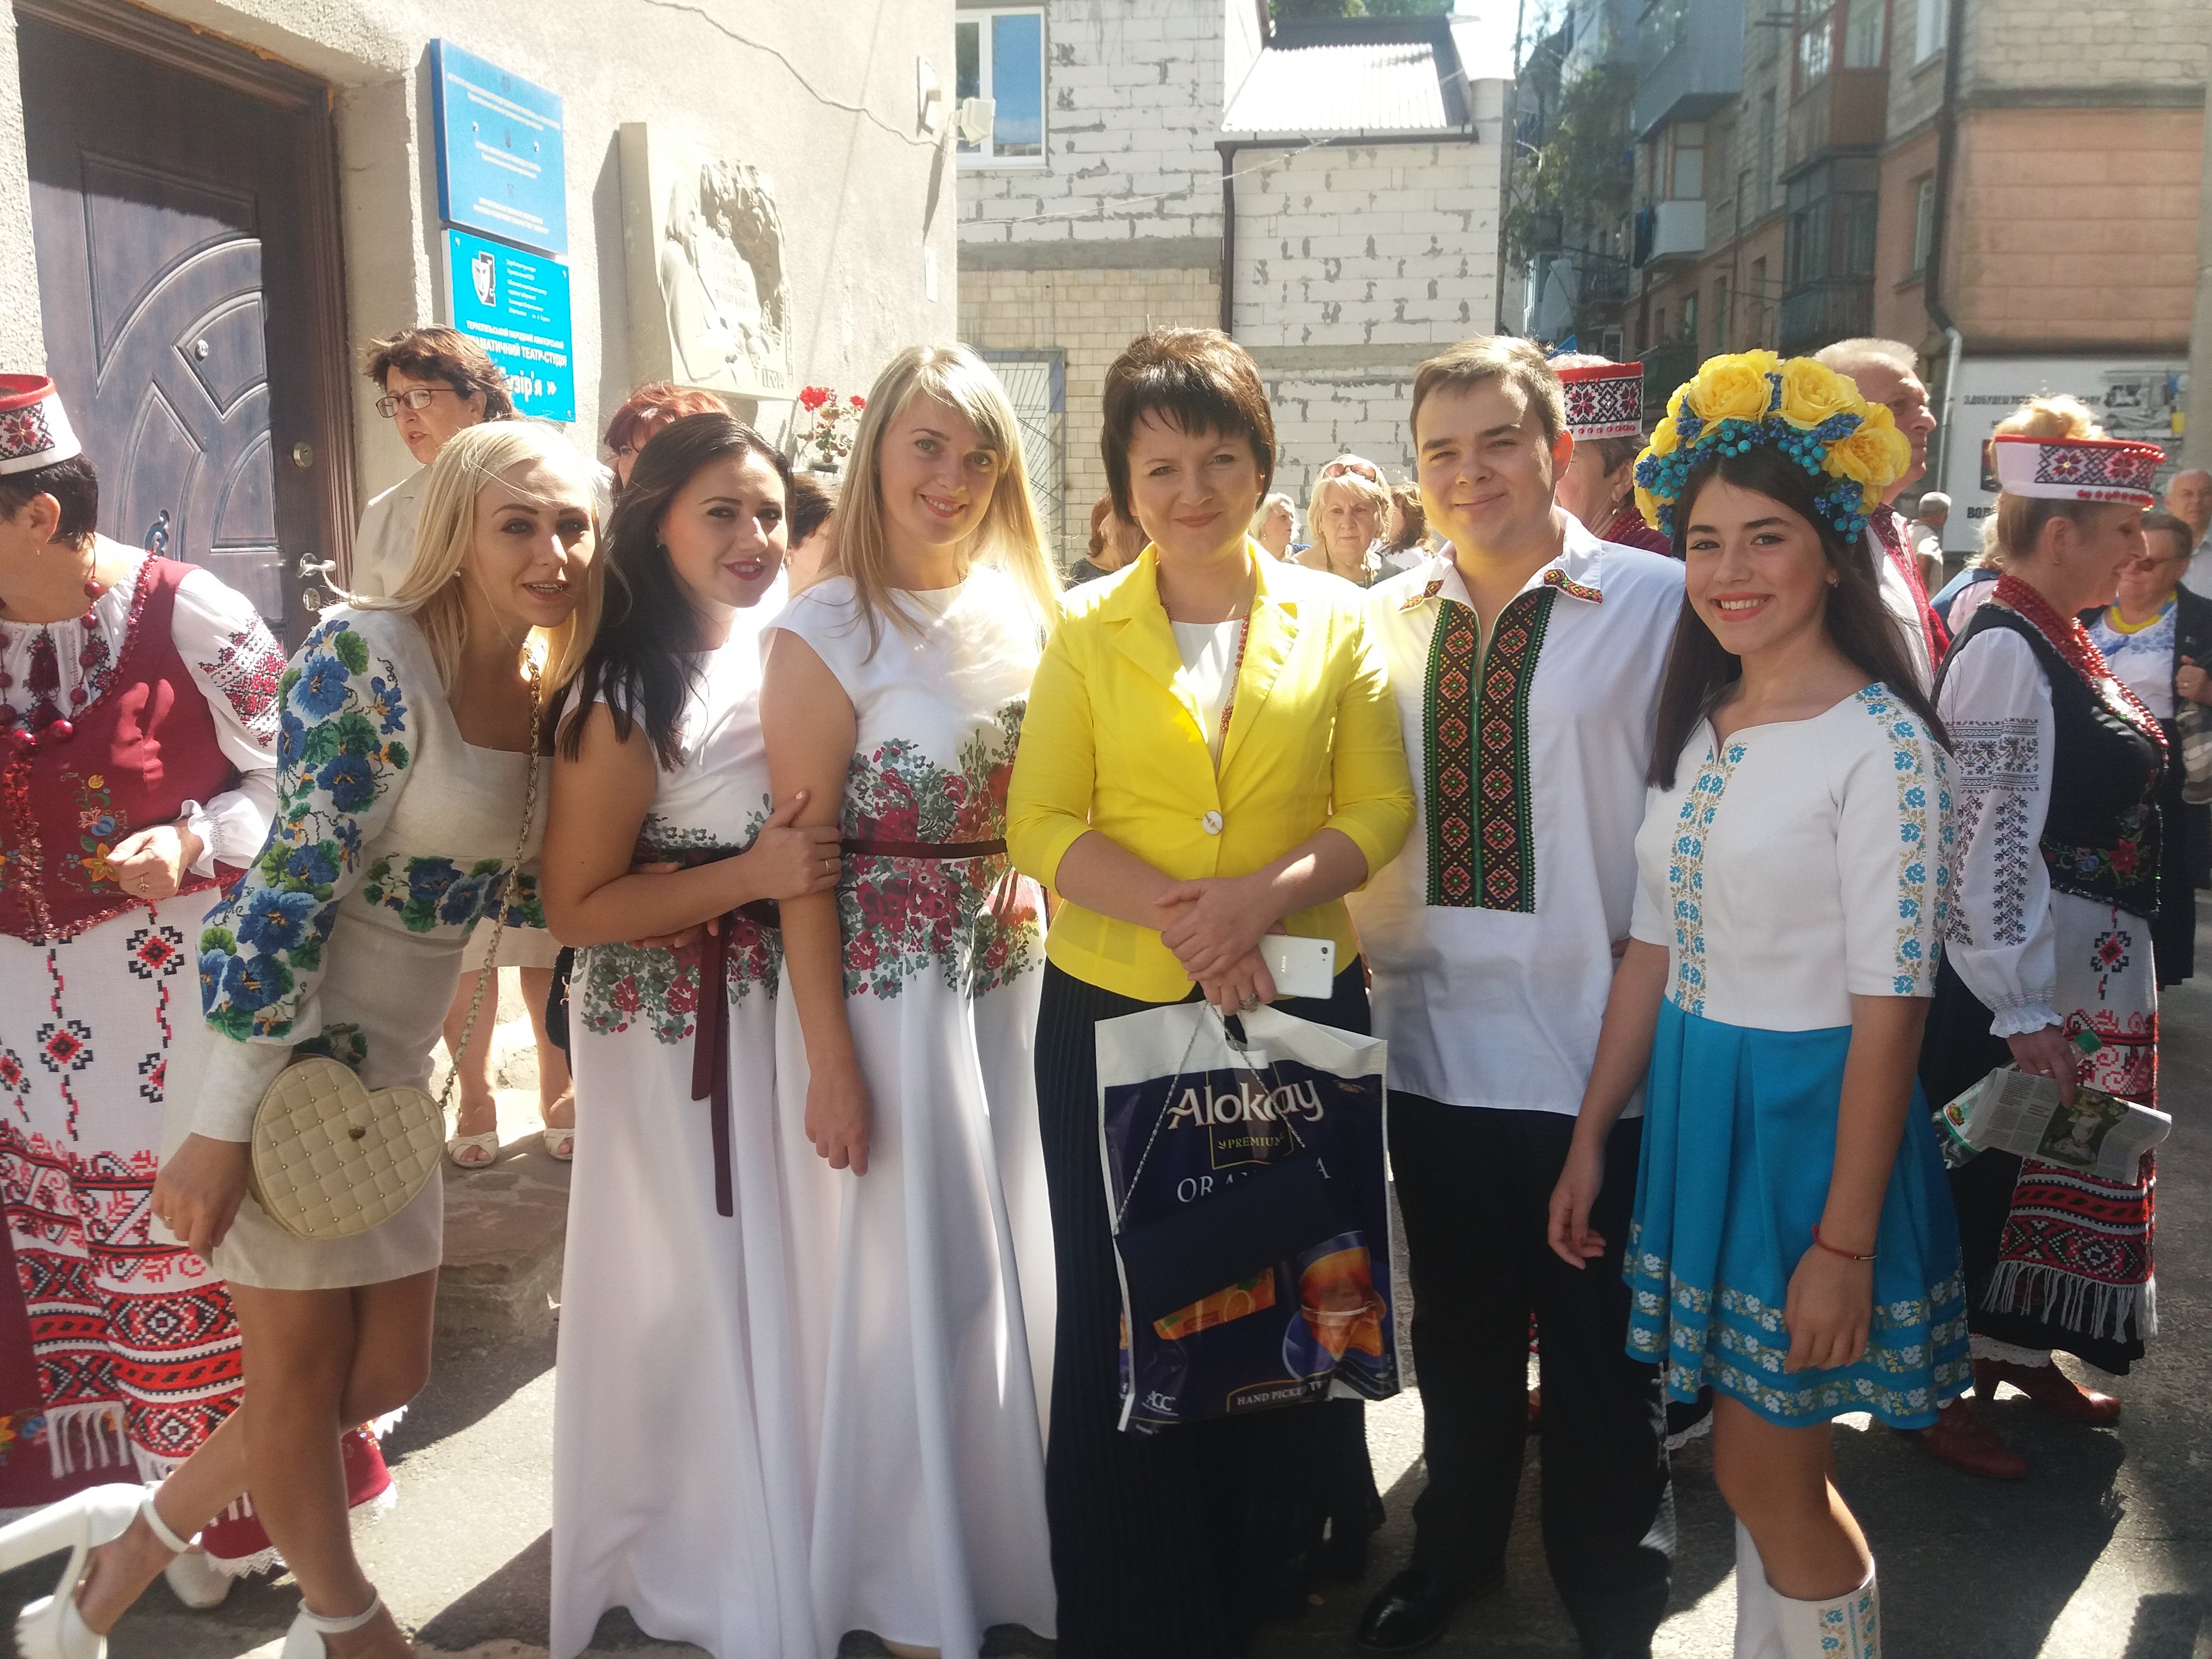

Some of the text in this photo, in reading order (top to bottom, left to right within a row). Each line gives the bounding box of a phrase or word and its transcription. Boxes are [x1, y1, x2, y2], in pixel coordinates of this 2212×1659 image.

[466, 335, 567, 368] АМАТИЧНИЙ ТЕАТР-СТУДІЯ
[1237, 1393, 1269, 1406] HAND
